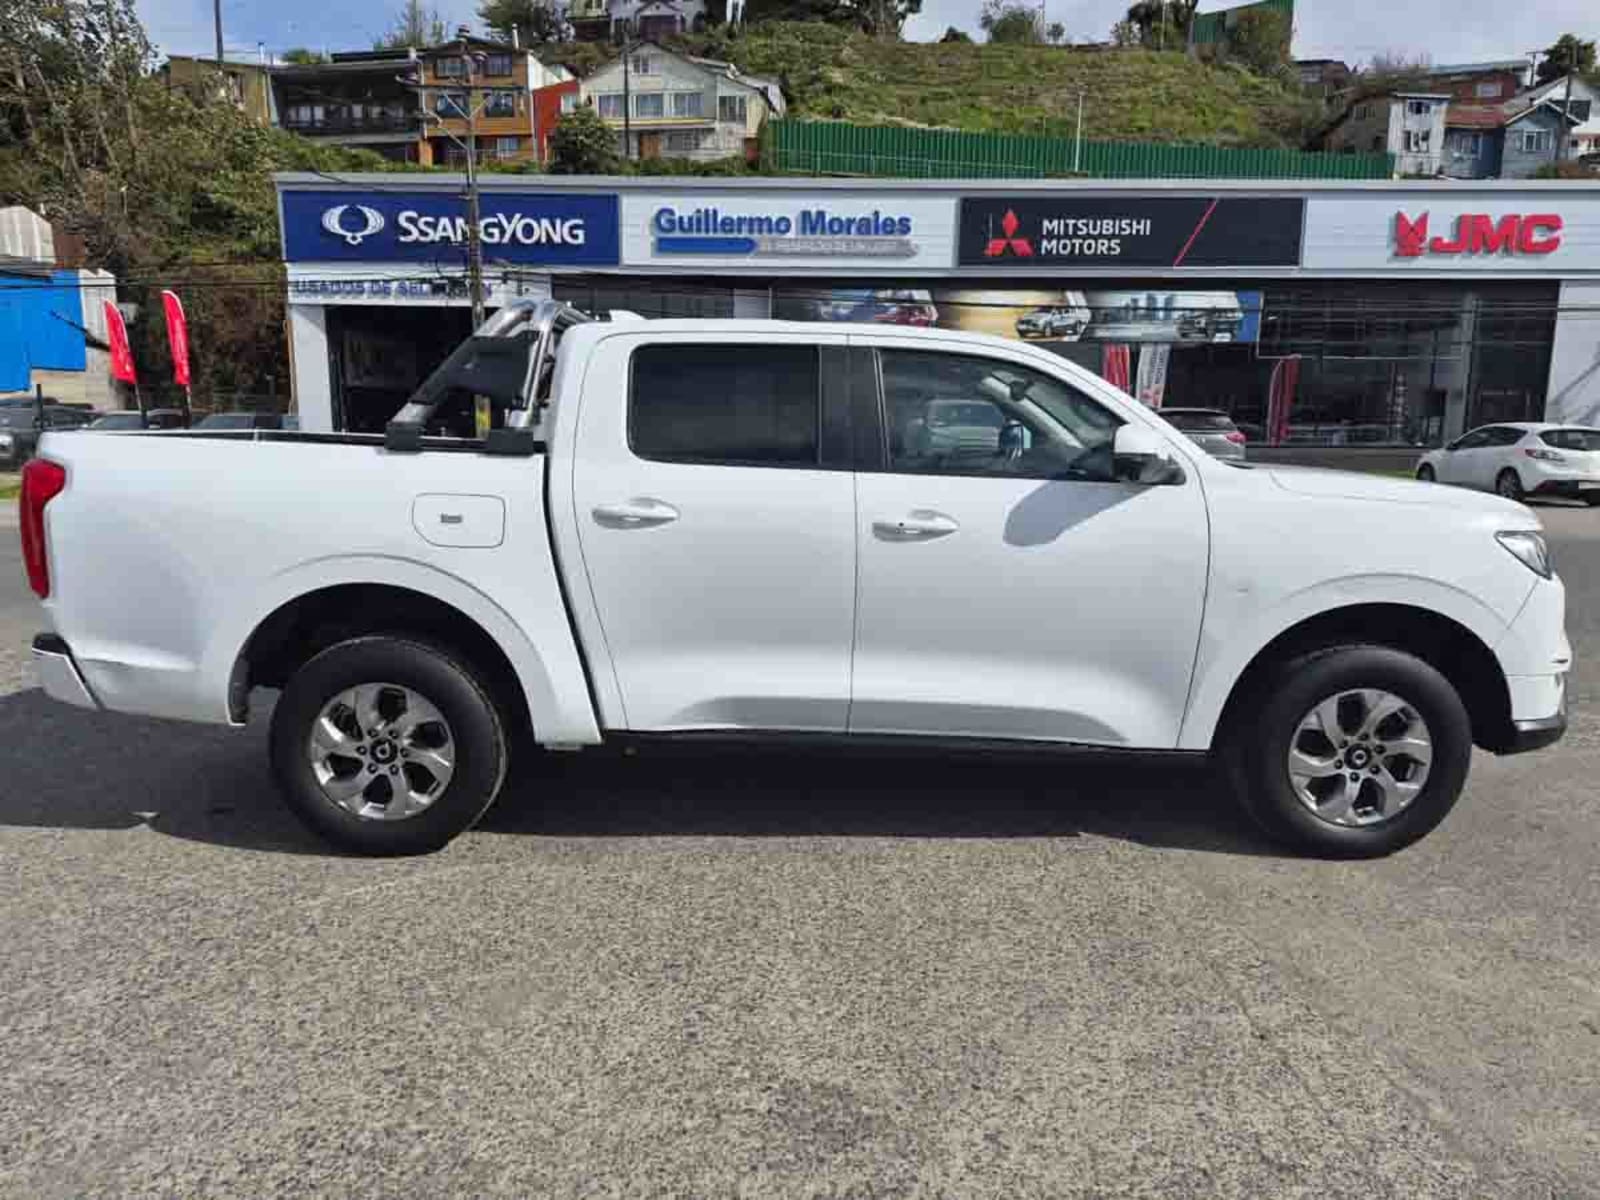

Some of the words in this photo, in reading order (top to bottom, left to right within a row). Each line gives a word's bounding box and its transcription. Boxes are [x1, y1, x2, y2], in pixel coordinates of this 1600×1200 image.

[654, 208, 792, 235] Guillermo
[799, 210, 912, 236] Morales
[1041, 218, 1151, 236] MITSUBISHI
[1429, 213, 1563, 254] JMC
[1041, 238, 1121, 256] MOTORS
